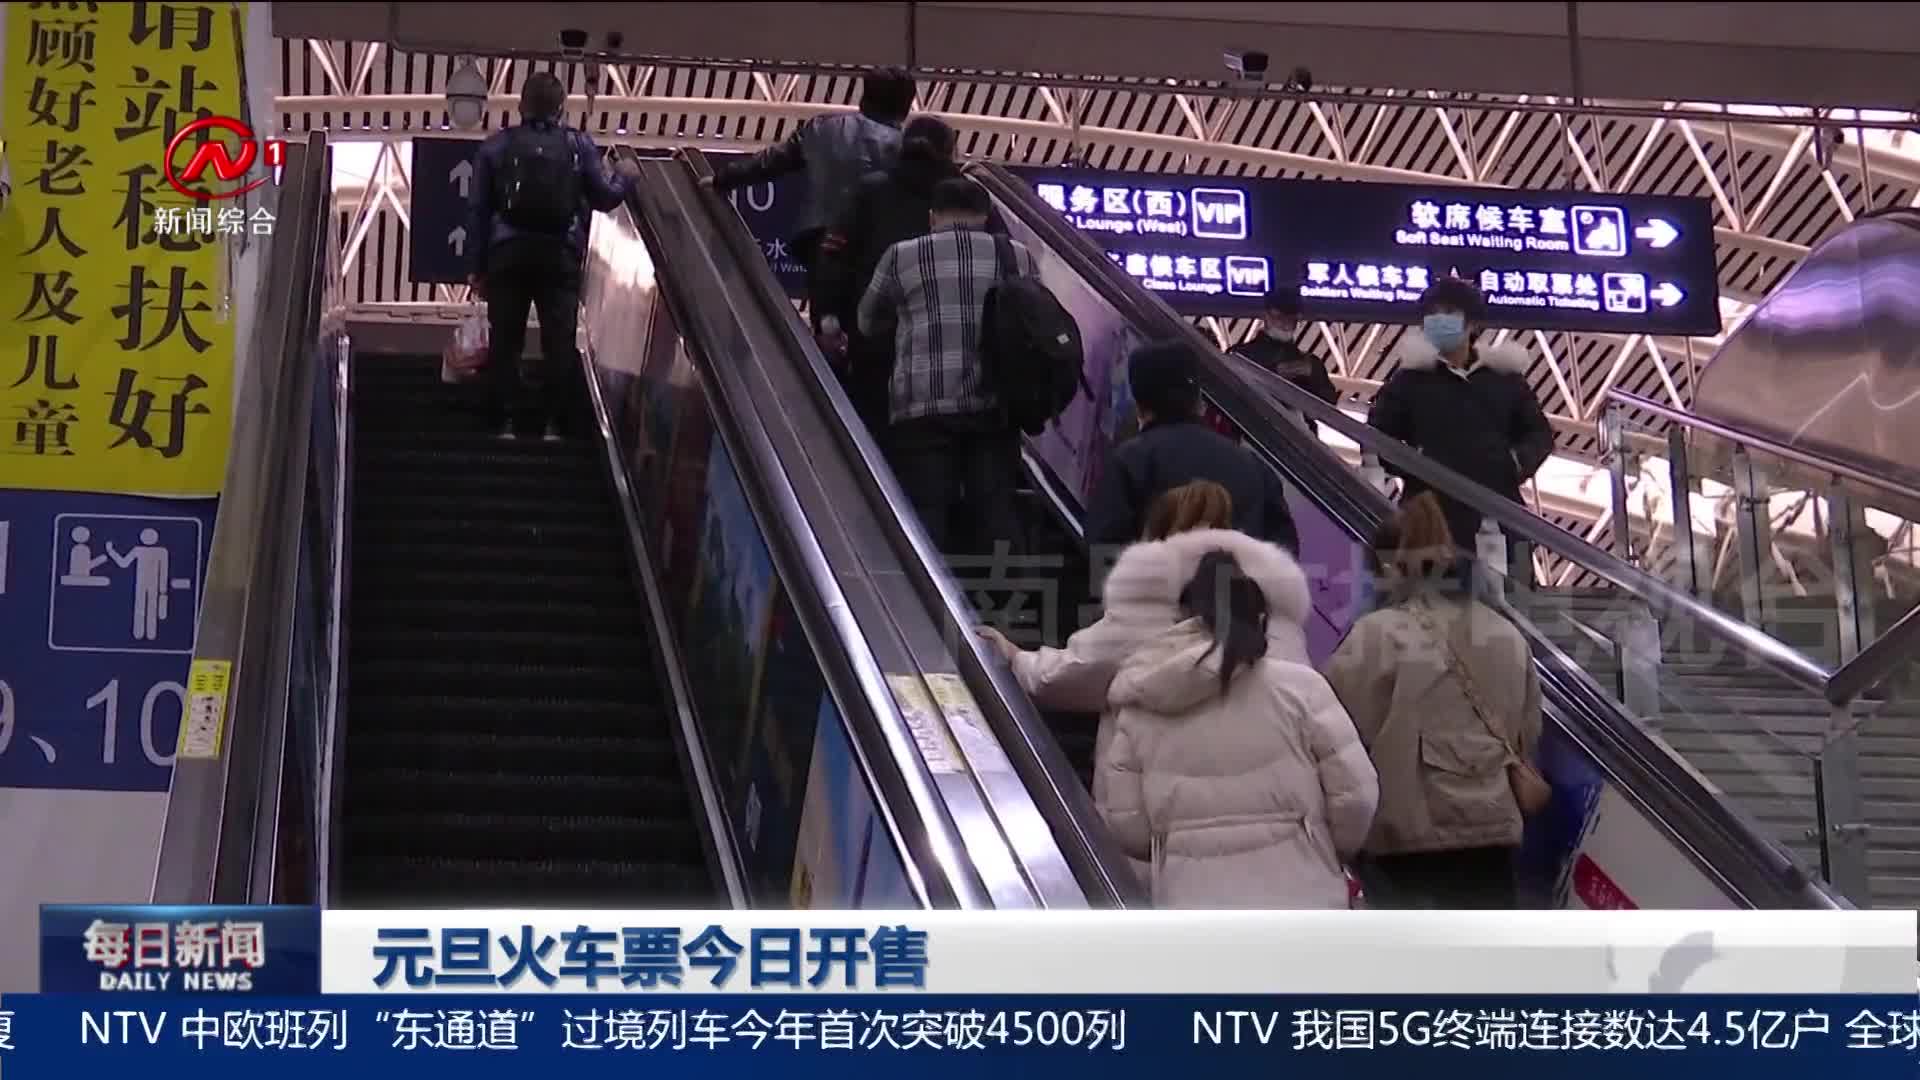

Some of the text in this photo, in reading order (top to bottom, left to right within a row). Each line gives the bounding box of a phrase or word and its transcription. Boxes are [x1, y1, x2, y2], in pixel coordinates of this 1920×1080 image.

[1197, 202, 1243, 225] VIP
[1411, 201, 1567, 234] 软席候车室
[12, 2, 98, 457] 顾好老人及儿童
[1076, 216, 1134, 234] Lounge
[1136, 218, 1187, 237] (West)
[1396, 230, 1569, 251] Soft Seat Waiting Room
[1108, 252, 1266, 285] 座候车区 VIP
[1308, 263, 1429, 289] 军人候车室
[1178, 281, 1223, 295] Lounge
[1480, 269, 1598, 296] 自动取票处
[1488, 294, 1546, 306] Automatic
